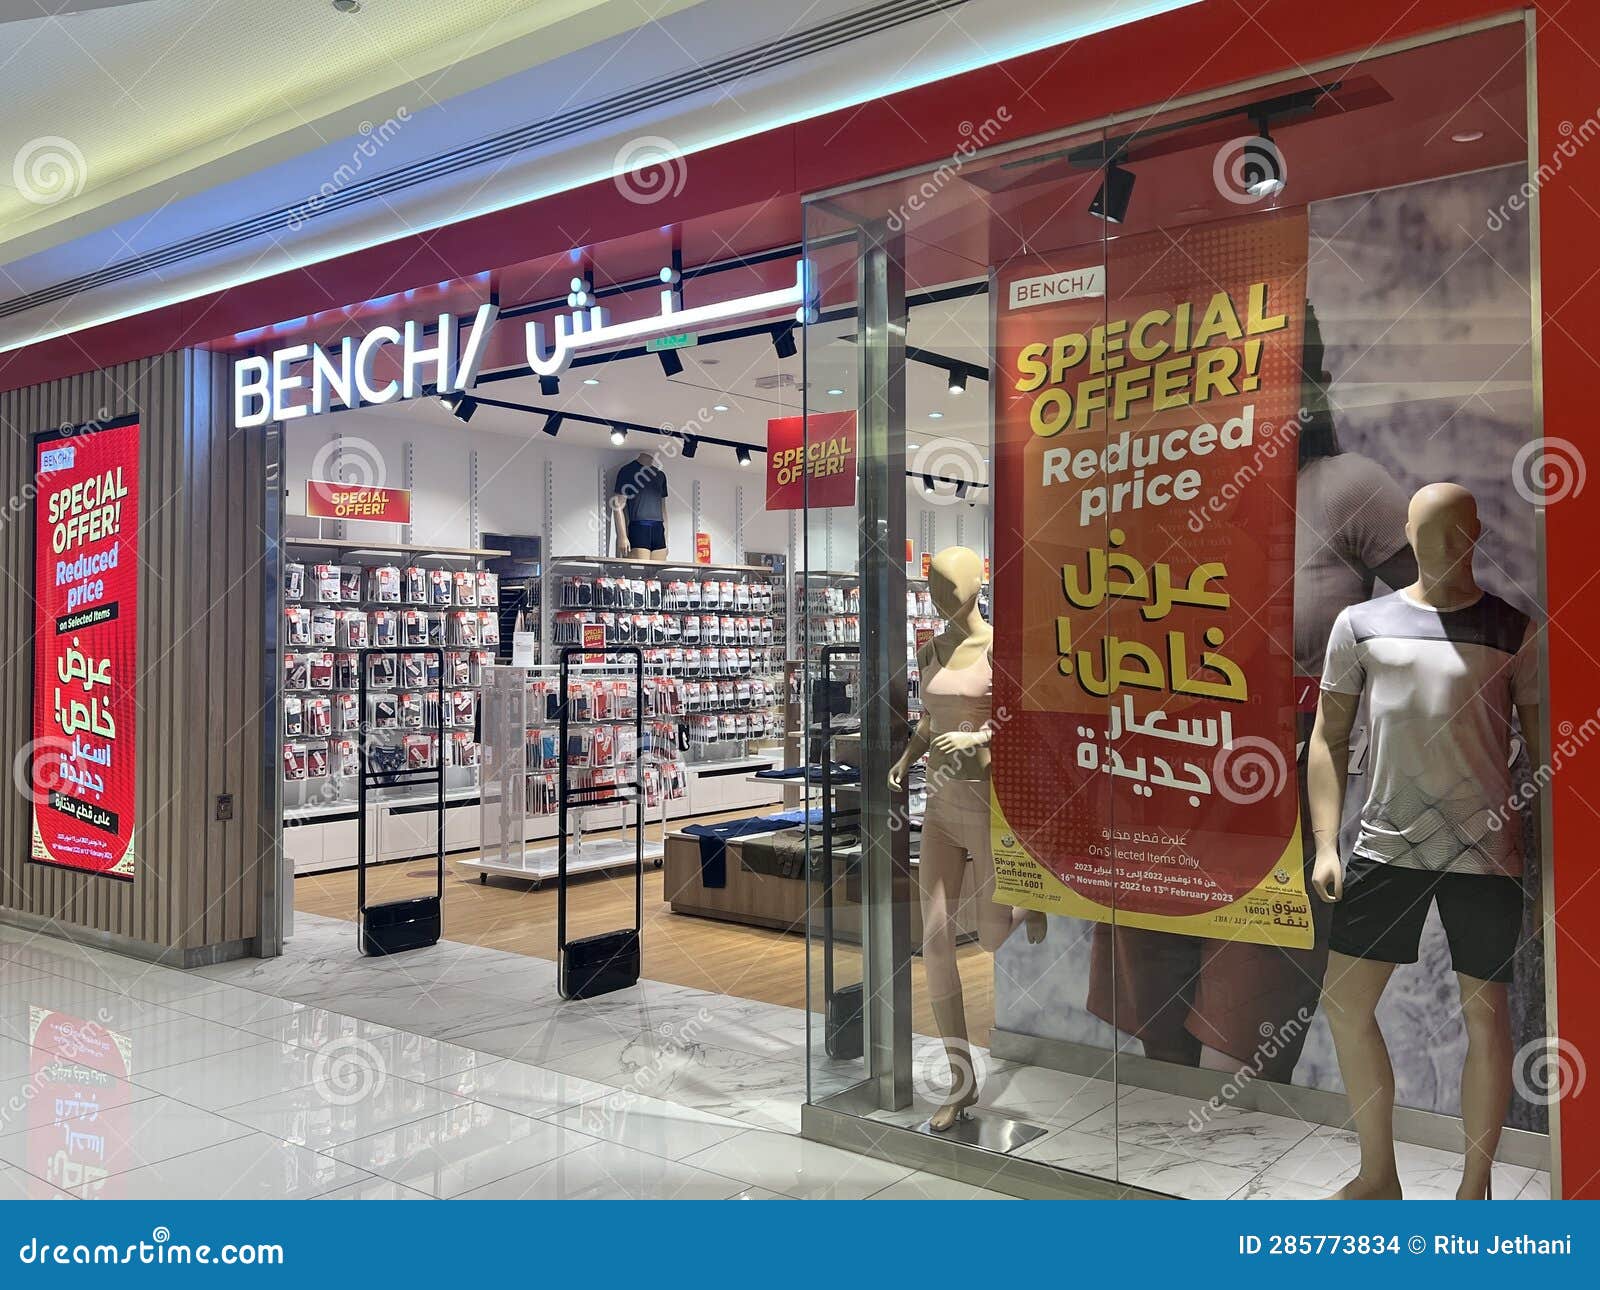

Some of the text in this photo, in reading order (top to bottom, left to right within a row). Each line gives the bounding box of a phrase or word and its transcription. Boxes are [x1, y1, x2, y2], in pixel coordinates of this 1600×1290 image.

[1017, 273, 1096, 302] BENCH/
[1015, 282, 1288, 392] SPECIAL
[234, 303, 499, 428] BENCH/
[1029, 339, 1263, 438] OFFER!
[772, 435, 852, 470] SPECIAL
[1042, 405, 1255, 486] Reduced
[776, 455, 845, 486] OFFER!
[48, 466, 128, 524] SPECIAL
[331, 491, 390, 505] SPECIAL
[335, 502, 386, 516] OFFER!
[1079, 469, 1202, 526] price
[52, 501, 120, 554] OFFER!
[55, 541, 119, 587] Reduced
[1061, 528, 1231, 620] عرض
[67, 578, 104, 613] price
[68, 611, 93, 628] Selected
[93, 608, 111, 622] Items
[57, 636, 112, 691] عرض
[1056, 616, 1249, 703] خاص!
[54, 687, 116, 740] خاص!
[1104, 694, 1233, 750] اسعار
[59, 752, 104, 800] جديدة
[1076, 726, 1212, 807] جديدة
[55, 793, 76, 813] مختارة
[76, 804, 93, 820] قطع
[1133, 831, 1159, 844] قطع
[994, 857, 1037, 869] Shop with
[1074, 862, 1093, 872] 2023
[1088, 844, 1200, 869] On Slected Items Only
[1115, 868, 1125, 876] 13
[996, 867, 1042, 880] Confidence
[1020, 879, 1044, 890] 16001
[1076, 875, 1118, 889] Novembr
[1120, 881, 1141, 891] 2022
[1142, 884, 1152, 893] to
[1170, 887, 1210, 901] February
[1211, 891, 1234, 903] 2023
[1143, 871, 1163, 880] 2022
[1244, 905, 1270, 916] 16001
